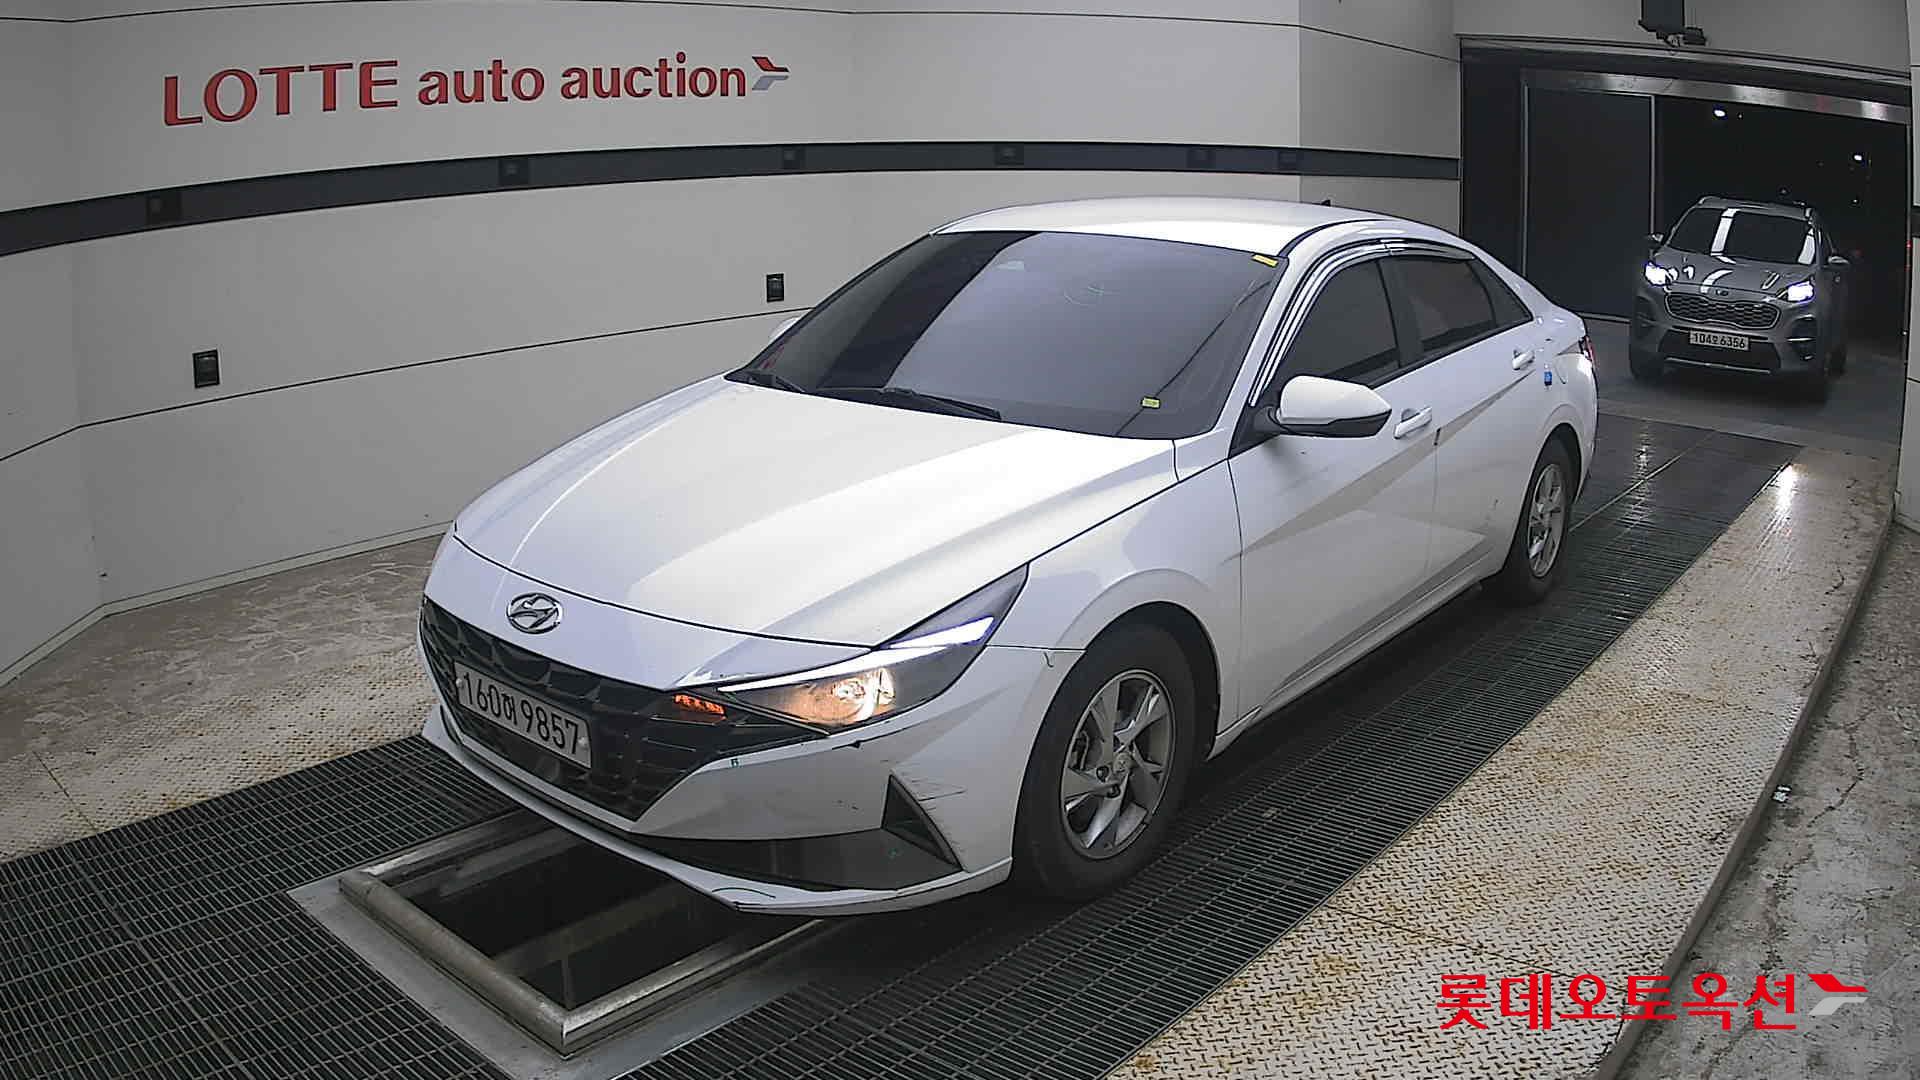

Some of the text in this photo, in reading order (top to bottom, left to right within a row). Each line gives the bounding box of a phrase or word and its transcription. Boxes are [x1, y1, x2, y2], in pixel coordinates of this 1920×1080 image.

[164, 51, 747, 126] LOTTE auto auction
[521, 700, 578, 754] 9857
